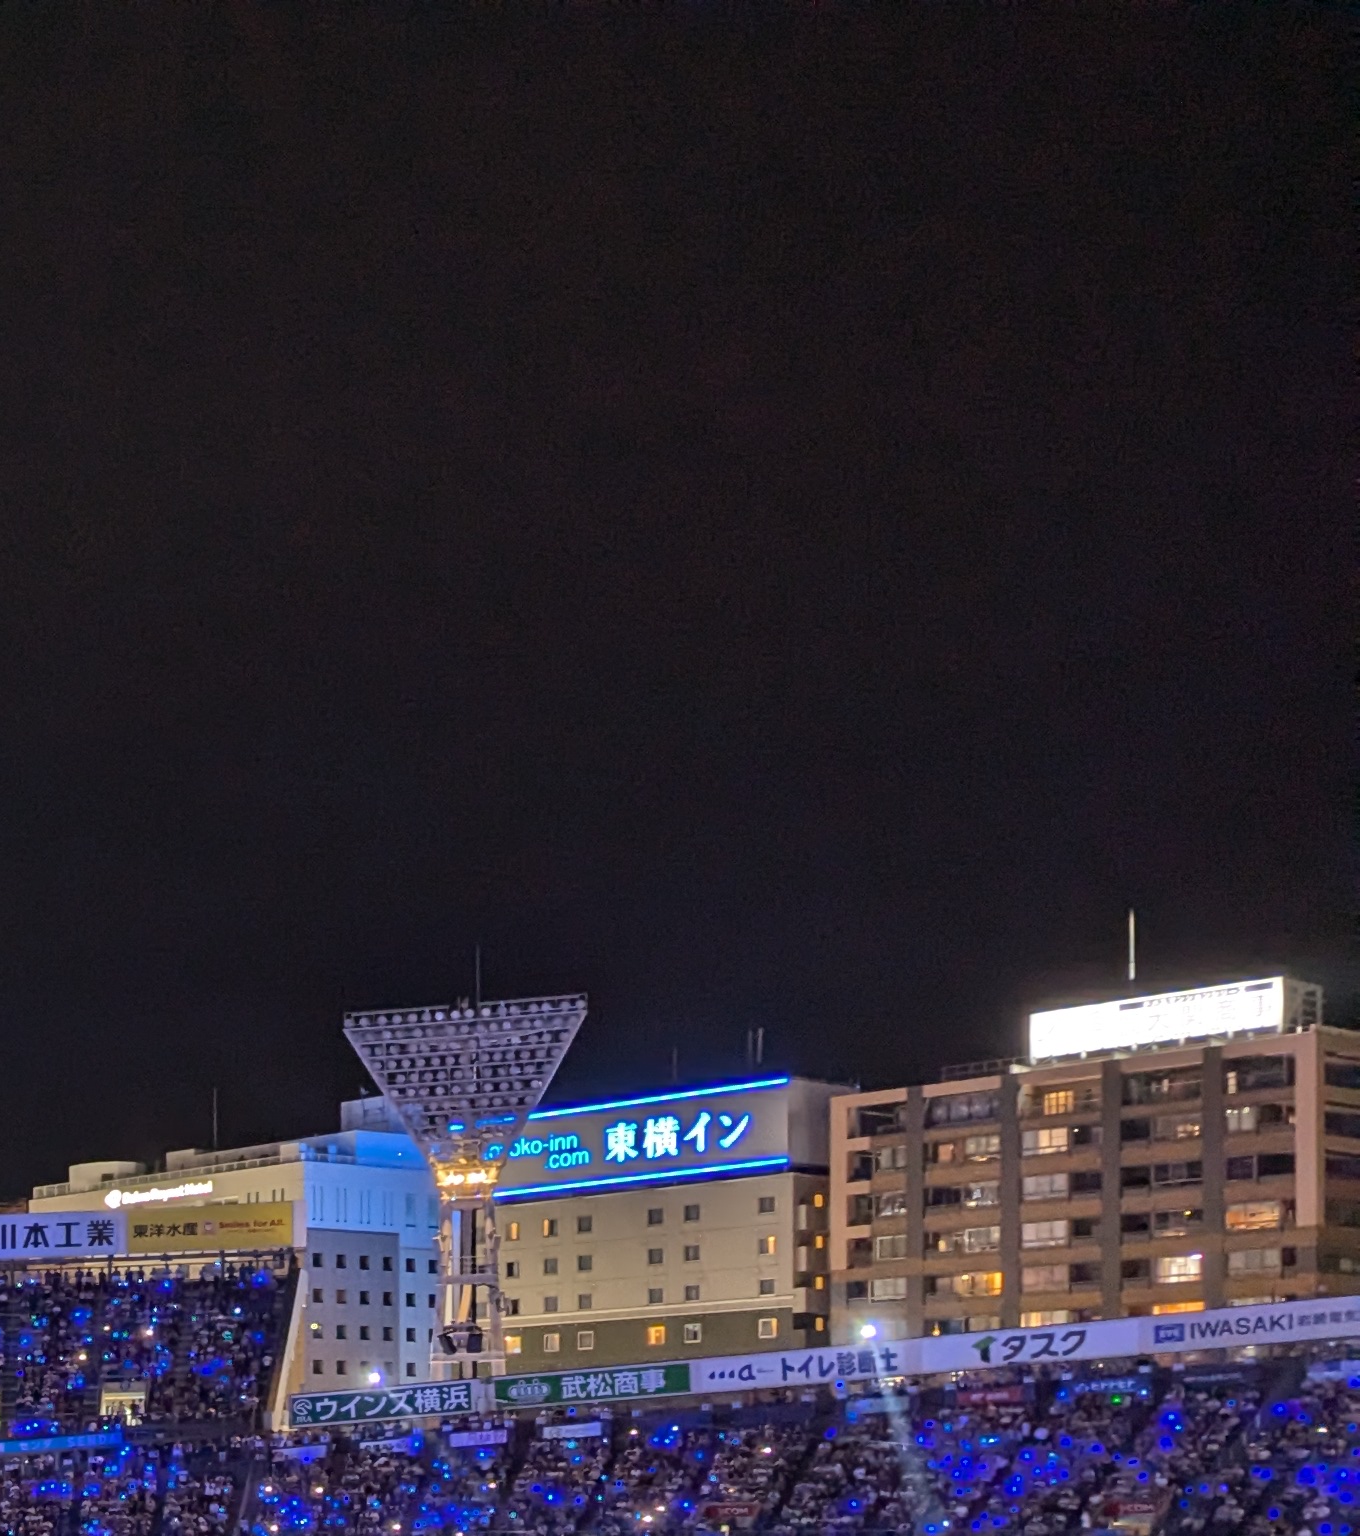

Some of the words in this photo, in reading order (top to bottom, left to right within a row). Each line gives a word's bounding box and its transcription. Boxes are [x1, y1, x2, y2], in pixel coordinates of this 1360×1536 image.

[604, 1112, 752, 1164] 東横イン
[544, 1148, 590, 1170] .com
[132, 1222, 198, 1239] 東洋水産
[218, 1220, 250, 1229] Smiles
[253, 1218, 268, 1228] for
[1189, 1313, 1294, 1339] IWASAKI
[1000, 1329, 1087, 1362] タスク
[781, 1346, 898, 1382] トイレ診断士
[560, 1368, 667, 1399] 武松商事
[314, 1383, 470, 1421] ウインズ横浜
